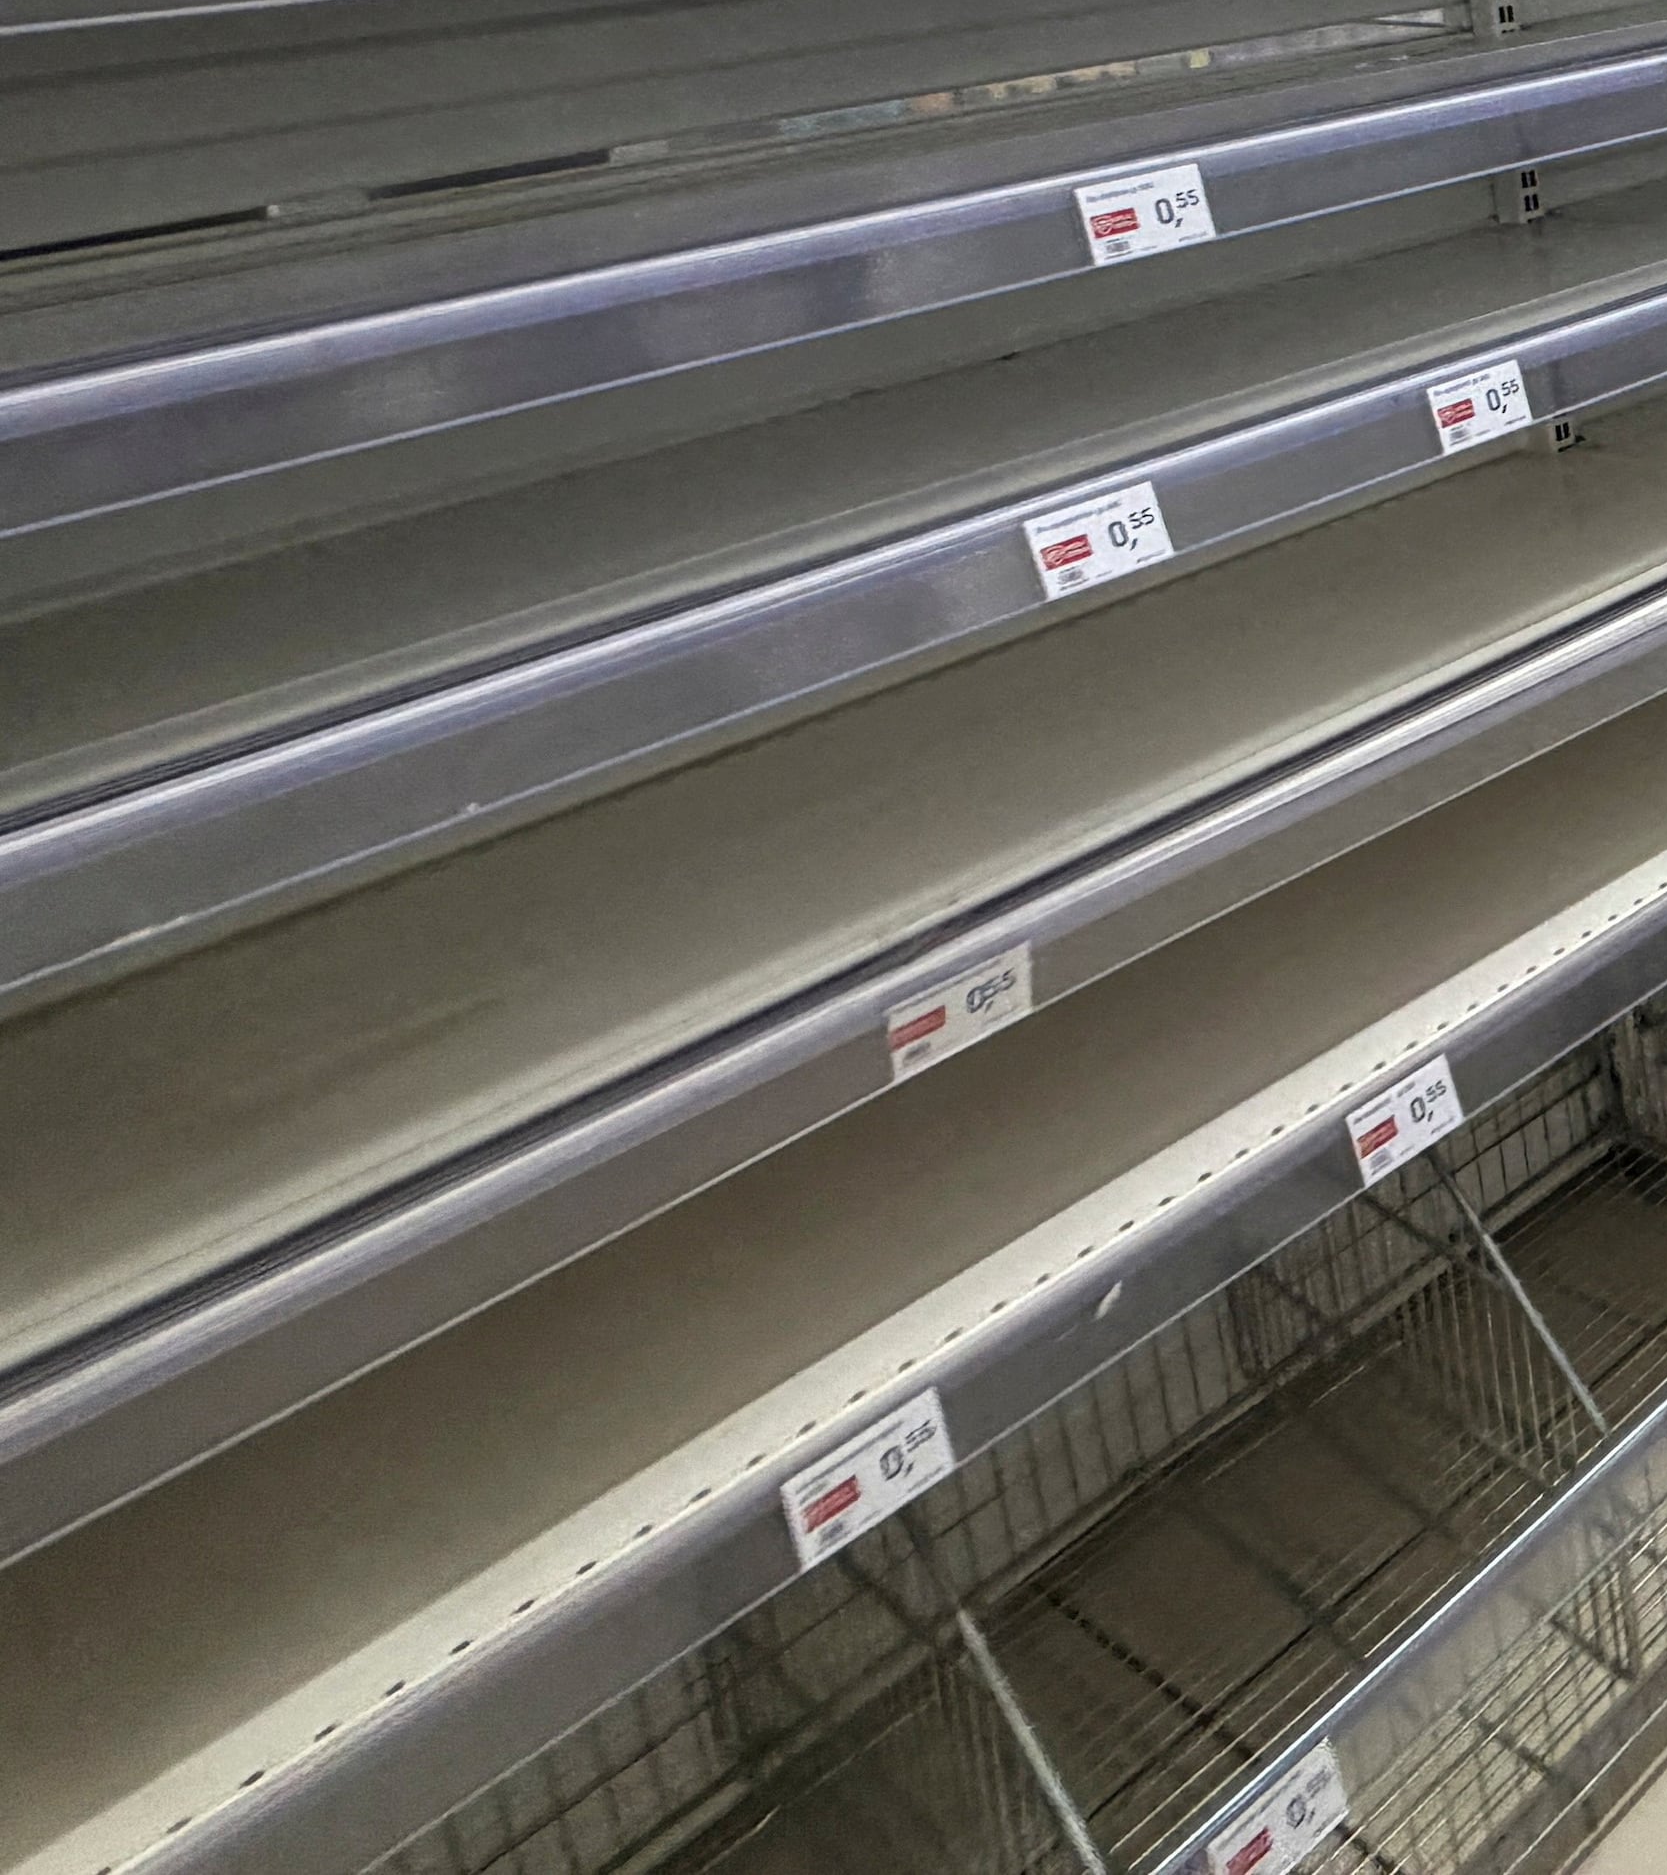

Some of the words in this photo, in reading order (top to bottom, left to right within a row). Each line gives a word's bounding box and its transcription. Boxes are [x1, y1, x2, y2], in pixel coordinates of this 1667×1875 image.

[1155, 189, 1200, 228] 0,55
[1486, 378, 1520, 414] 0,55
[1108, 507, 1155, 551] 0,55
[1409, 1080, 1448, 1124] 0,55
